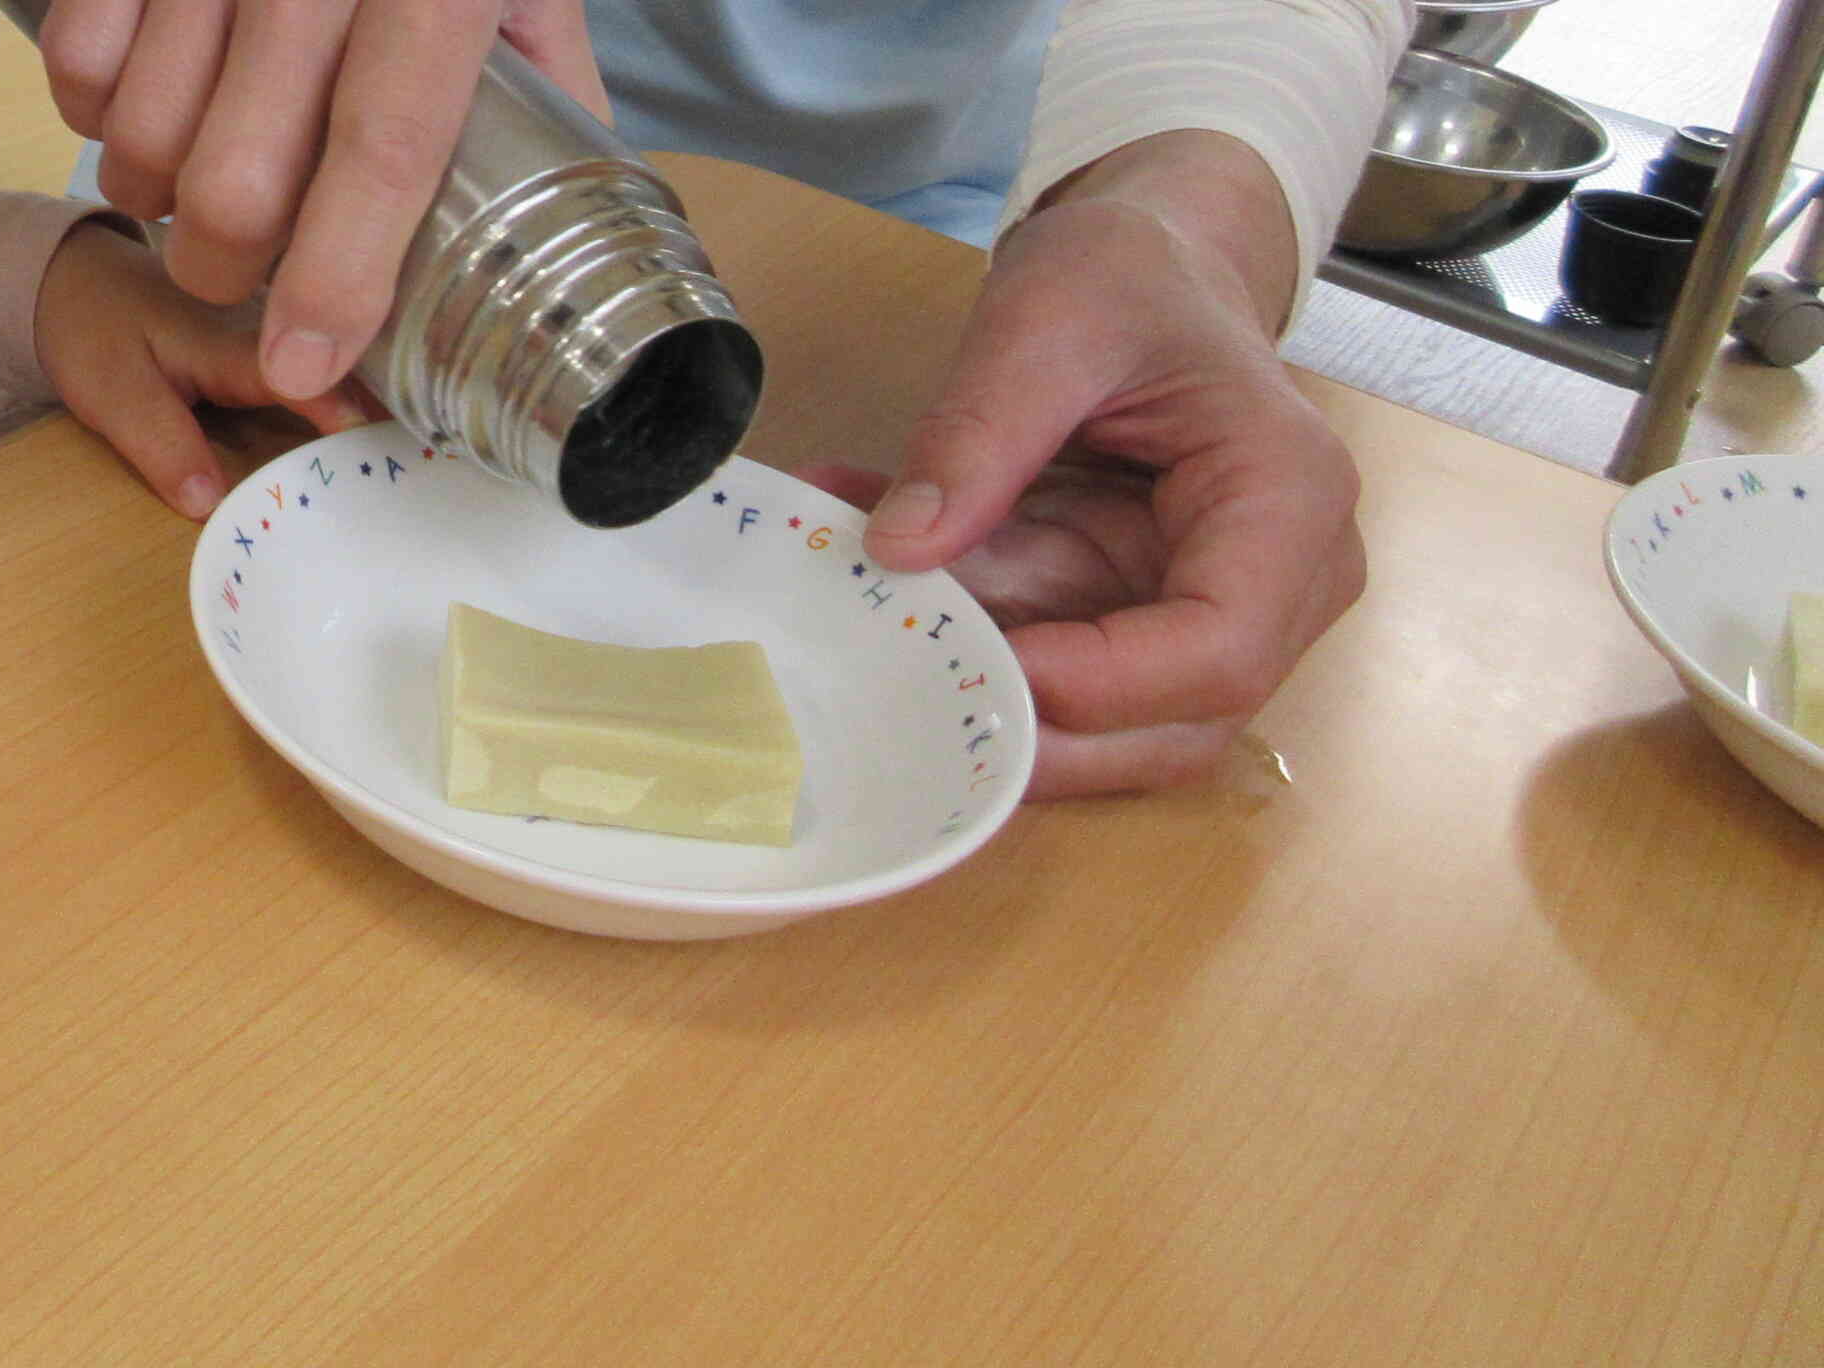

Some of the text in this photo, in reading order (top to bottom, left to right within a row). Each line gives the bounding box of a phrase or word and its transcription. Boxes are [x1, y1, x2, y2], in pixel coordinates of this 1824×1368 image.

[235, 526, 254, 558] X
[266, 482, 283, 511] Y
[310, 456, 335, 486] Z
[385, 456, 406, 482] A
[1679, 480, 1704, 505] L
[1738, 469, 1767, 496] M
[738, 507, 761, 534] F
[807, 526, 832, 550] G
[861, 579, 893, 610] H
[928, 613, 953, 639] I
[959, 672, 985, 690] J
